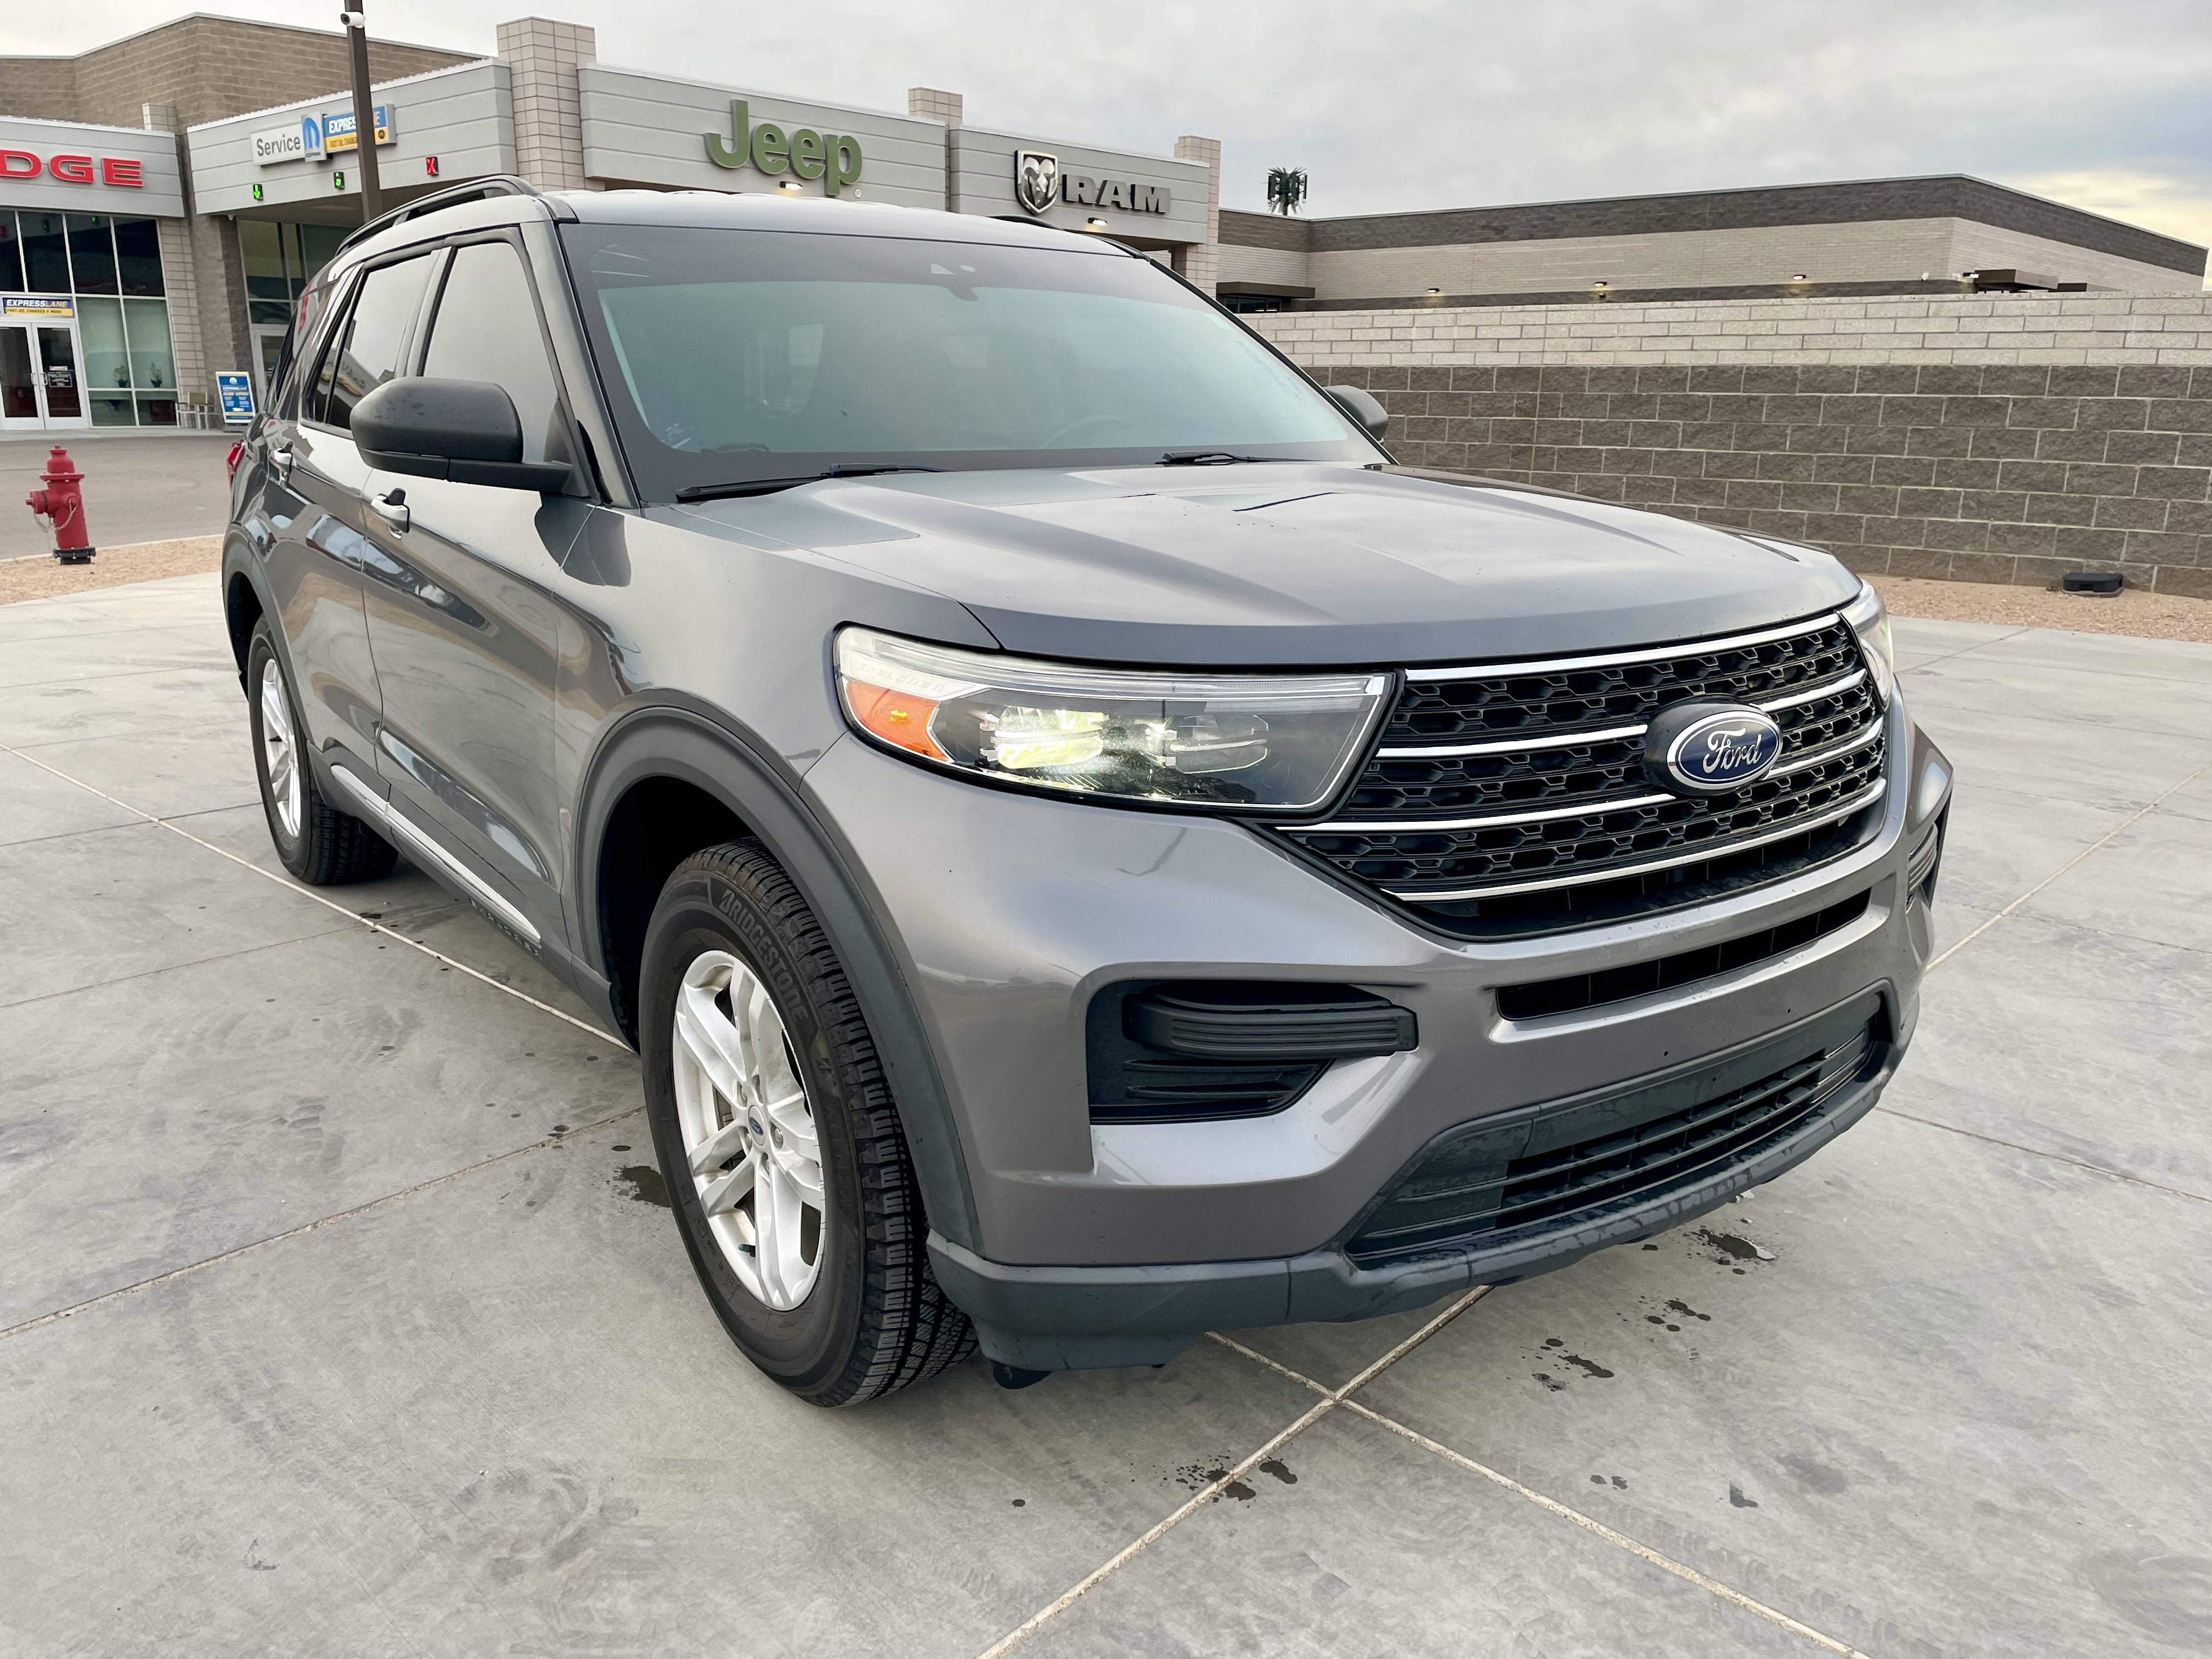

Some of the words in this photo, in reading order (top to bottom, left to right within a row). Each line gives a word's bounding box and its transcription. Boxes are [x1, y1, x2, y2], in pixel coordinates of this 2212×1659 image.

[256, 134, 301, 157] Service
[703, 99, 862, 197] Jeep
[1062, 174, 1171, 213] RAM
[1703, 727, 1762, 774] Ford
[719, 888, 809, 1023] BRIDGESTONE
